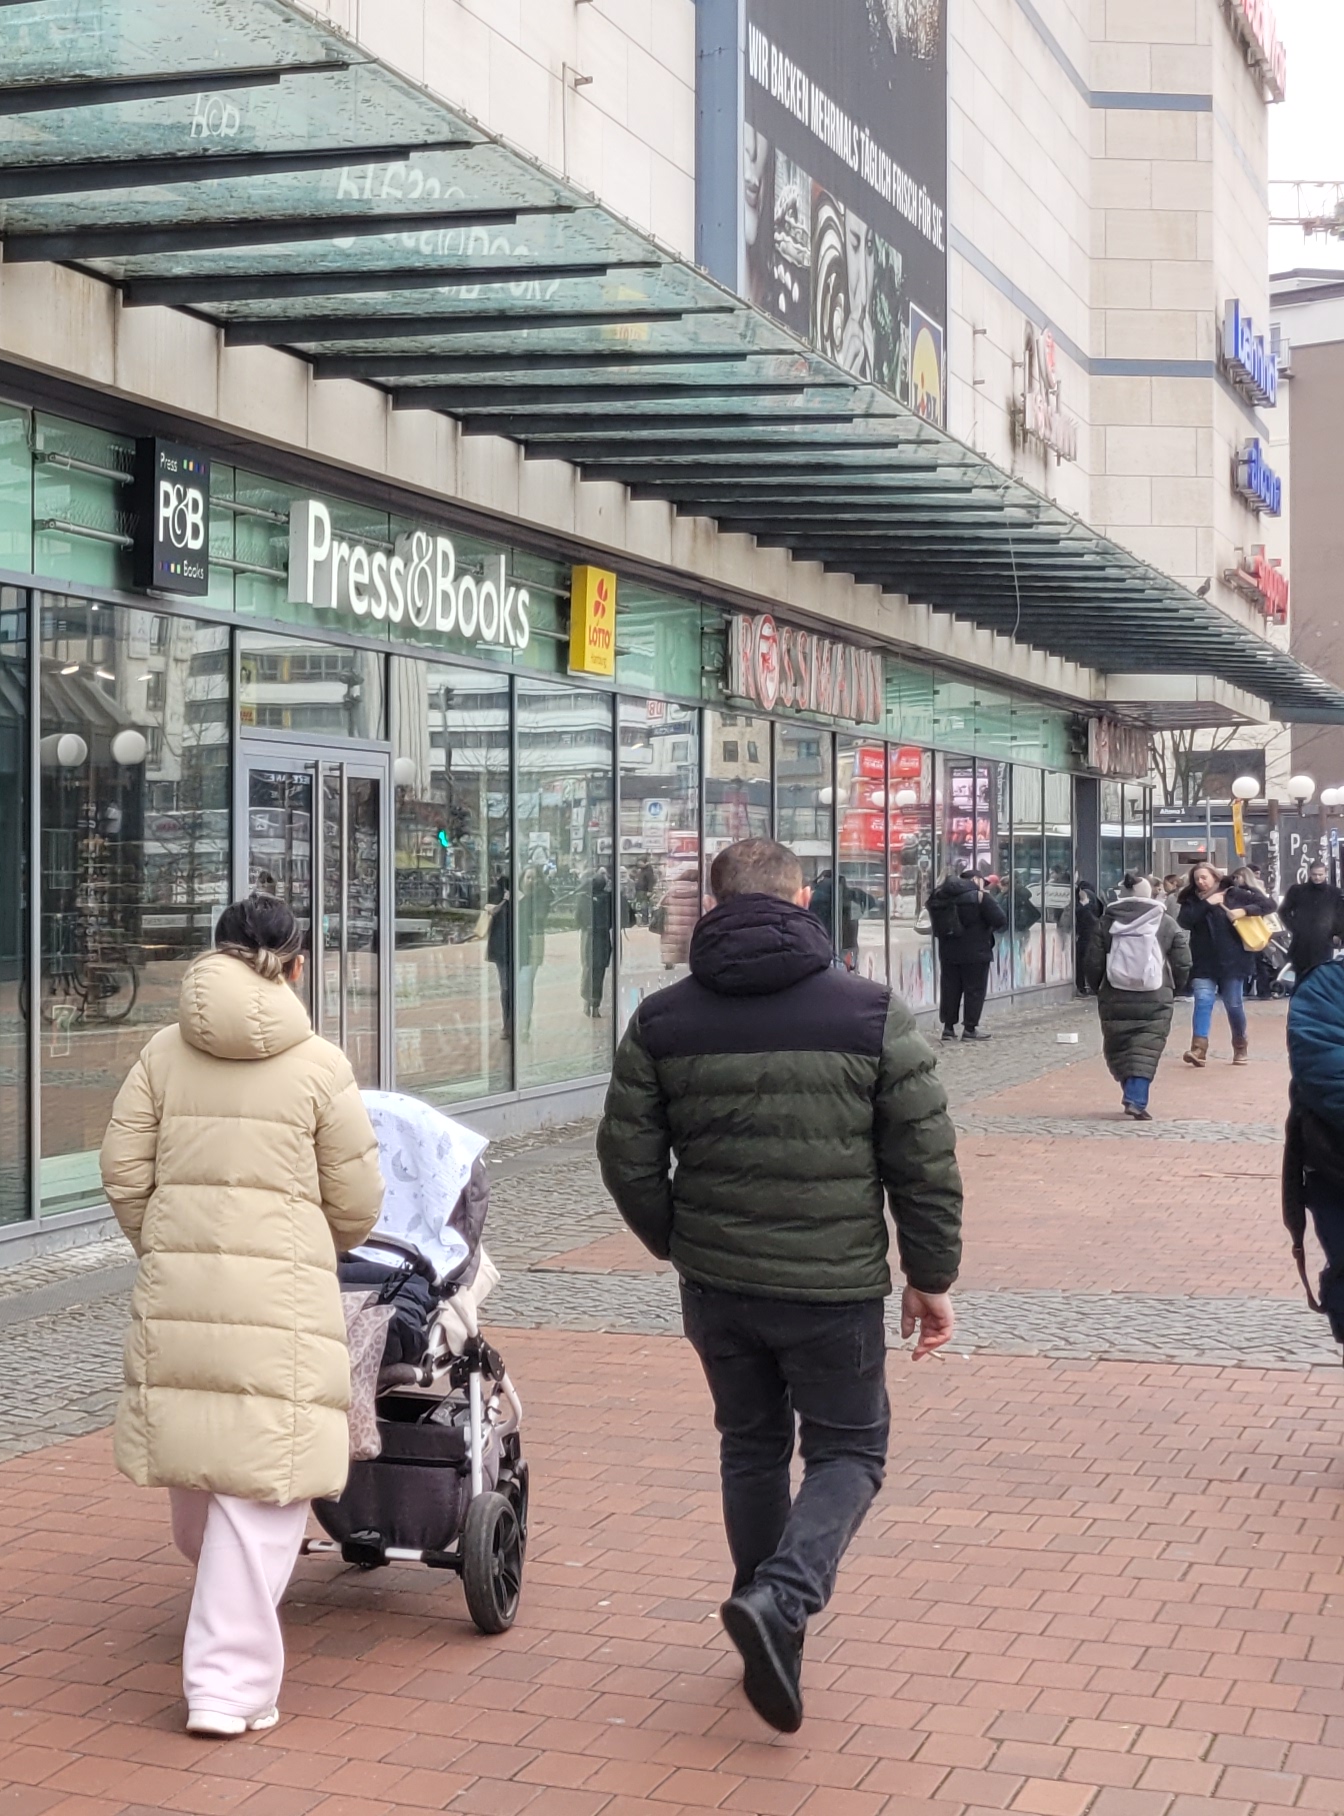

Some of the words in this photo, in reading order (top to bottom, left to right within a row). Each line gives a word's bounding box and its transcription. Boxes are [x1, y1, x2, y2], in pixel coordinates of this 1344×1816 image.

[748, 21, 769, 91] WIR
[771, 44, 809, 127] BACKEN
[810, 82, 860, 173] MEHRMALS
[860, 127, 892, 204] TÄGLICH
[892, 162, 918, 228] FRISCH
[918, 184, 932, 242] FÜR
[932, 202, 945, 253] SIE.
[159, 451, 178, 473] Press
[158, 480, 205, 550] P&B
[183, 559, 205, 580] Books
